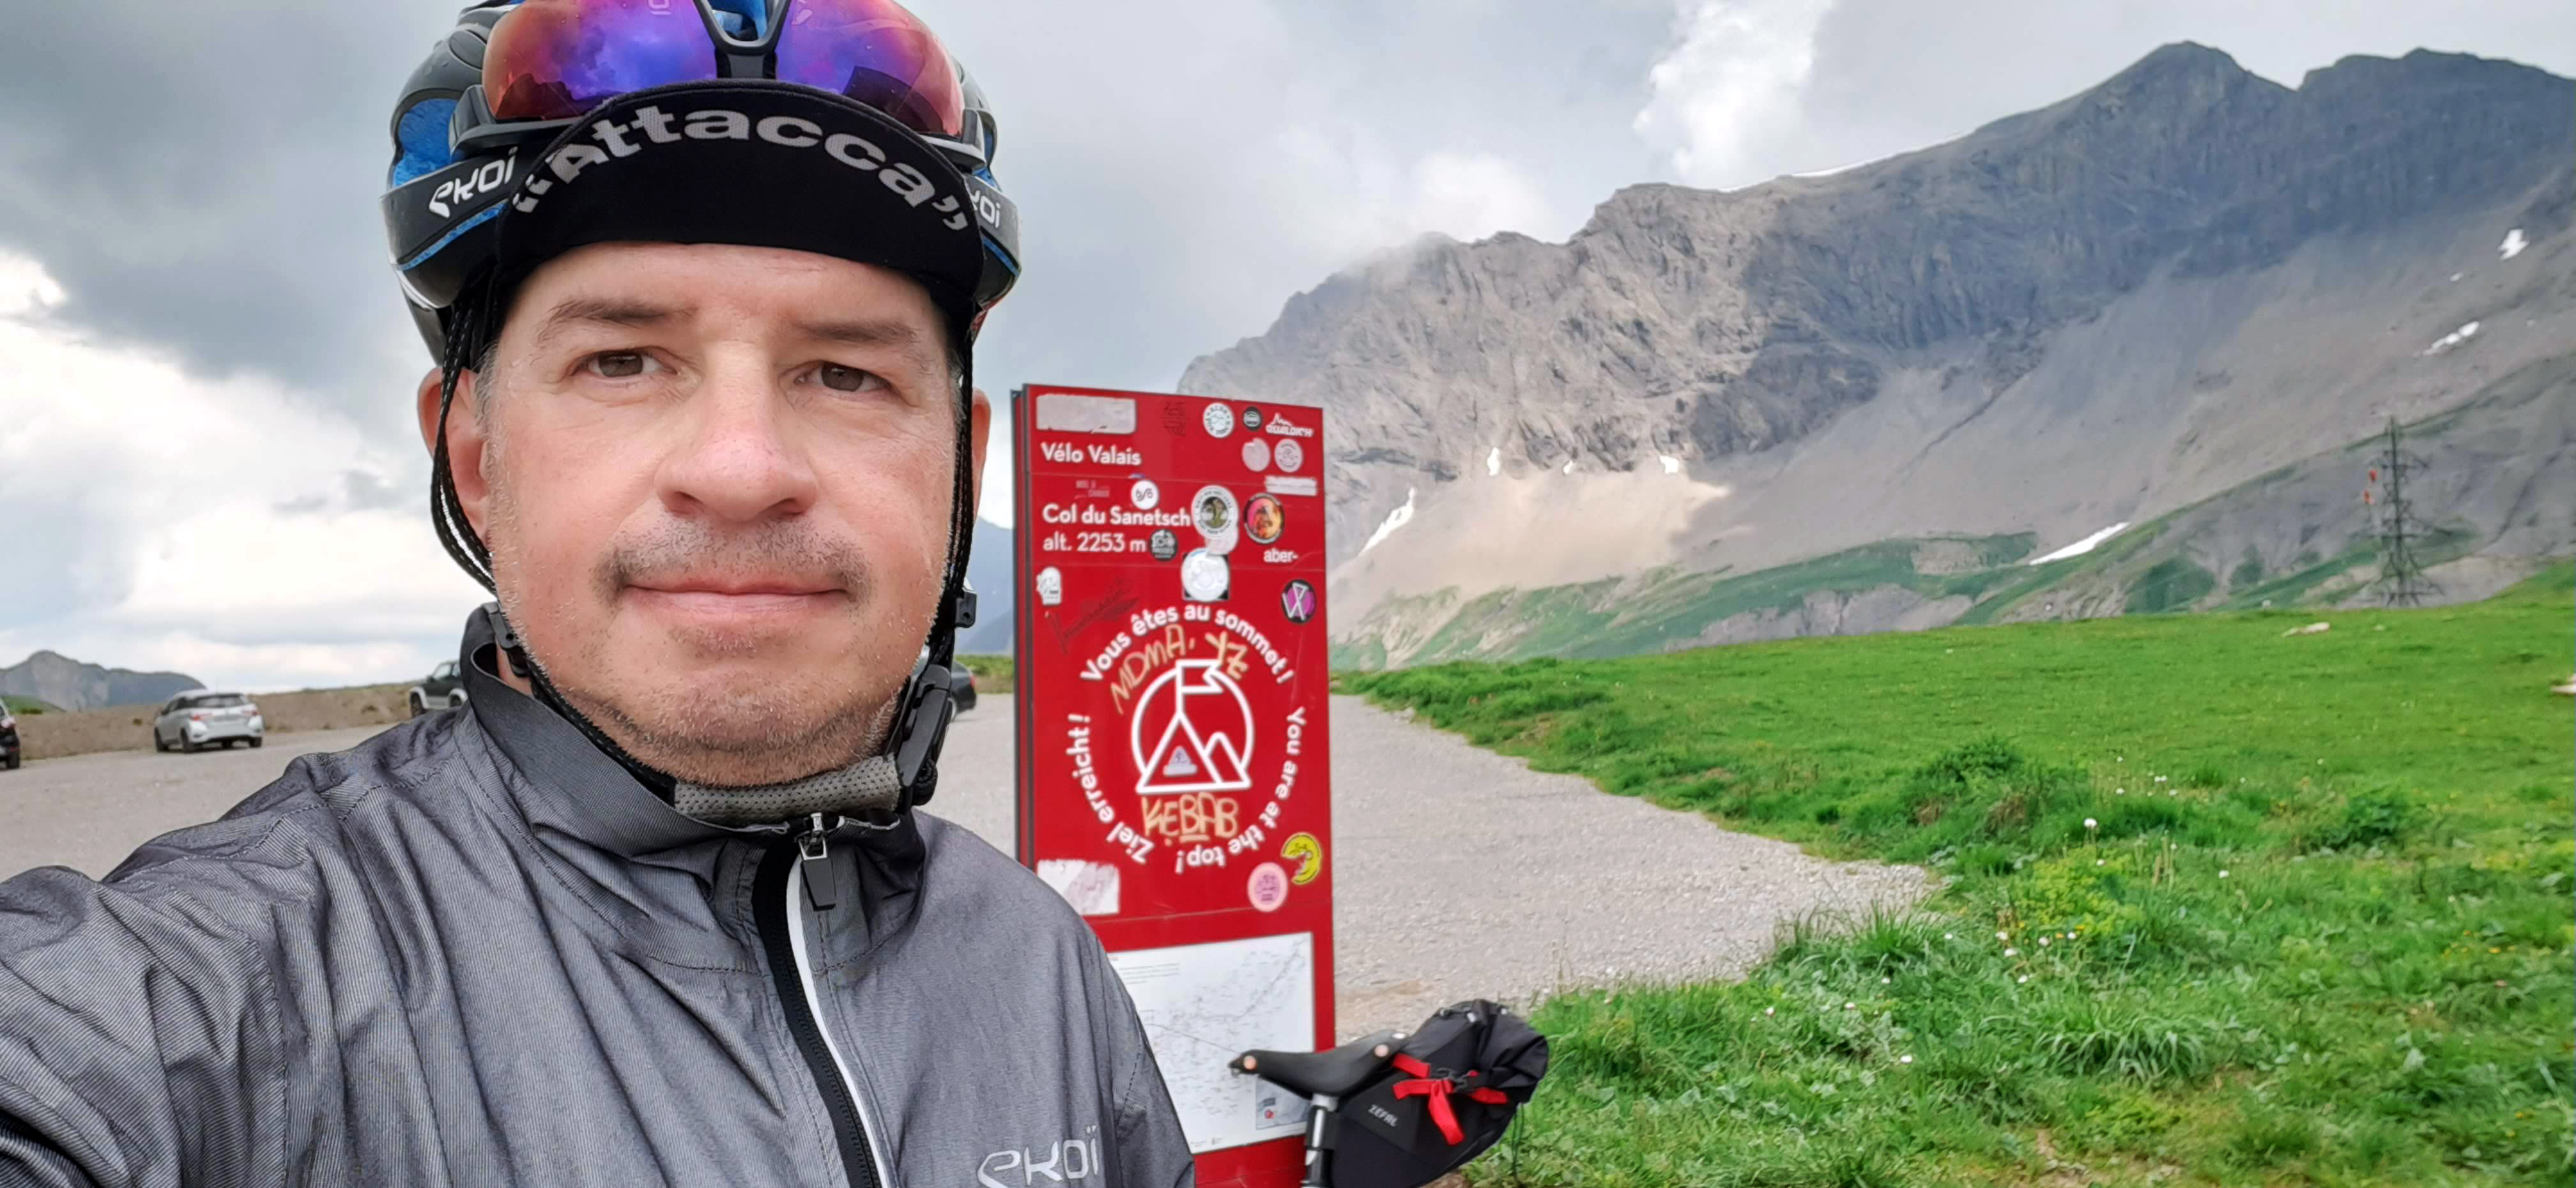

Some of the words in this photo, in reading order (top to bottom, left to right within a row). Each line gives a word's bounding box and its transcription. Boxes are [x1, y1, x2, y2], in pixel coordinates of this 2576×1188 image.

[1041, 441, 1084, 463] Vélo
[1087, 443, 1142, 466] Valais
[1043, 503, 1077, 524] Col
[1081, 504, 1106, 525] du
[1110, 505, 1191, 527] Sanetsch
[1043, 531, 1072, 551] alt.
[1077, 532, 1125, 553] 2253
[1130, 540, 1147, 553] m
[1264, 547, 1298, 563] aber-
[1080, 632, 1131, 681] Vous
[1131, 605, 1179, 636] êtes
[1184, 604, 1210, 621] au
[1287, 706, 1307, 756] You
[1275, 761, 1298, 799] are
[1259, 801, 1280, 828] at
[1105, 821, 1155, 864] Ziel
[1227, 825, 1264, 855] the
